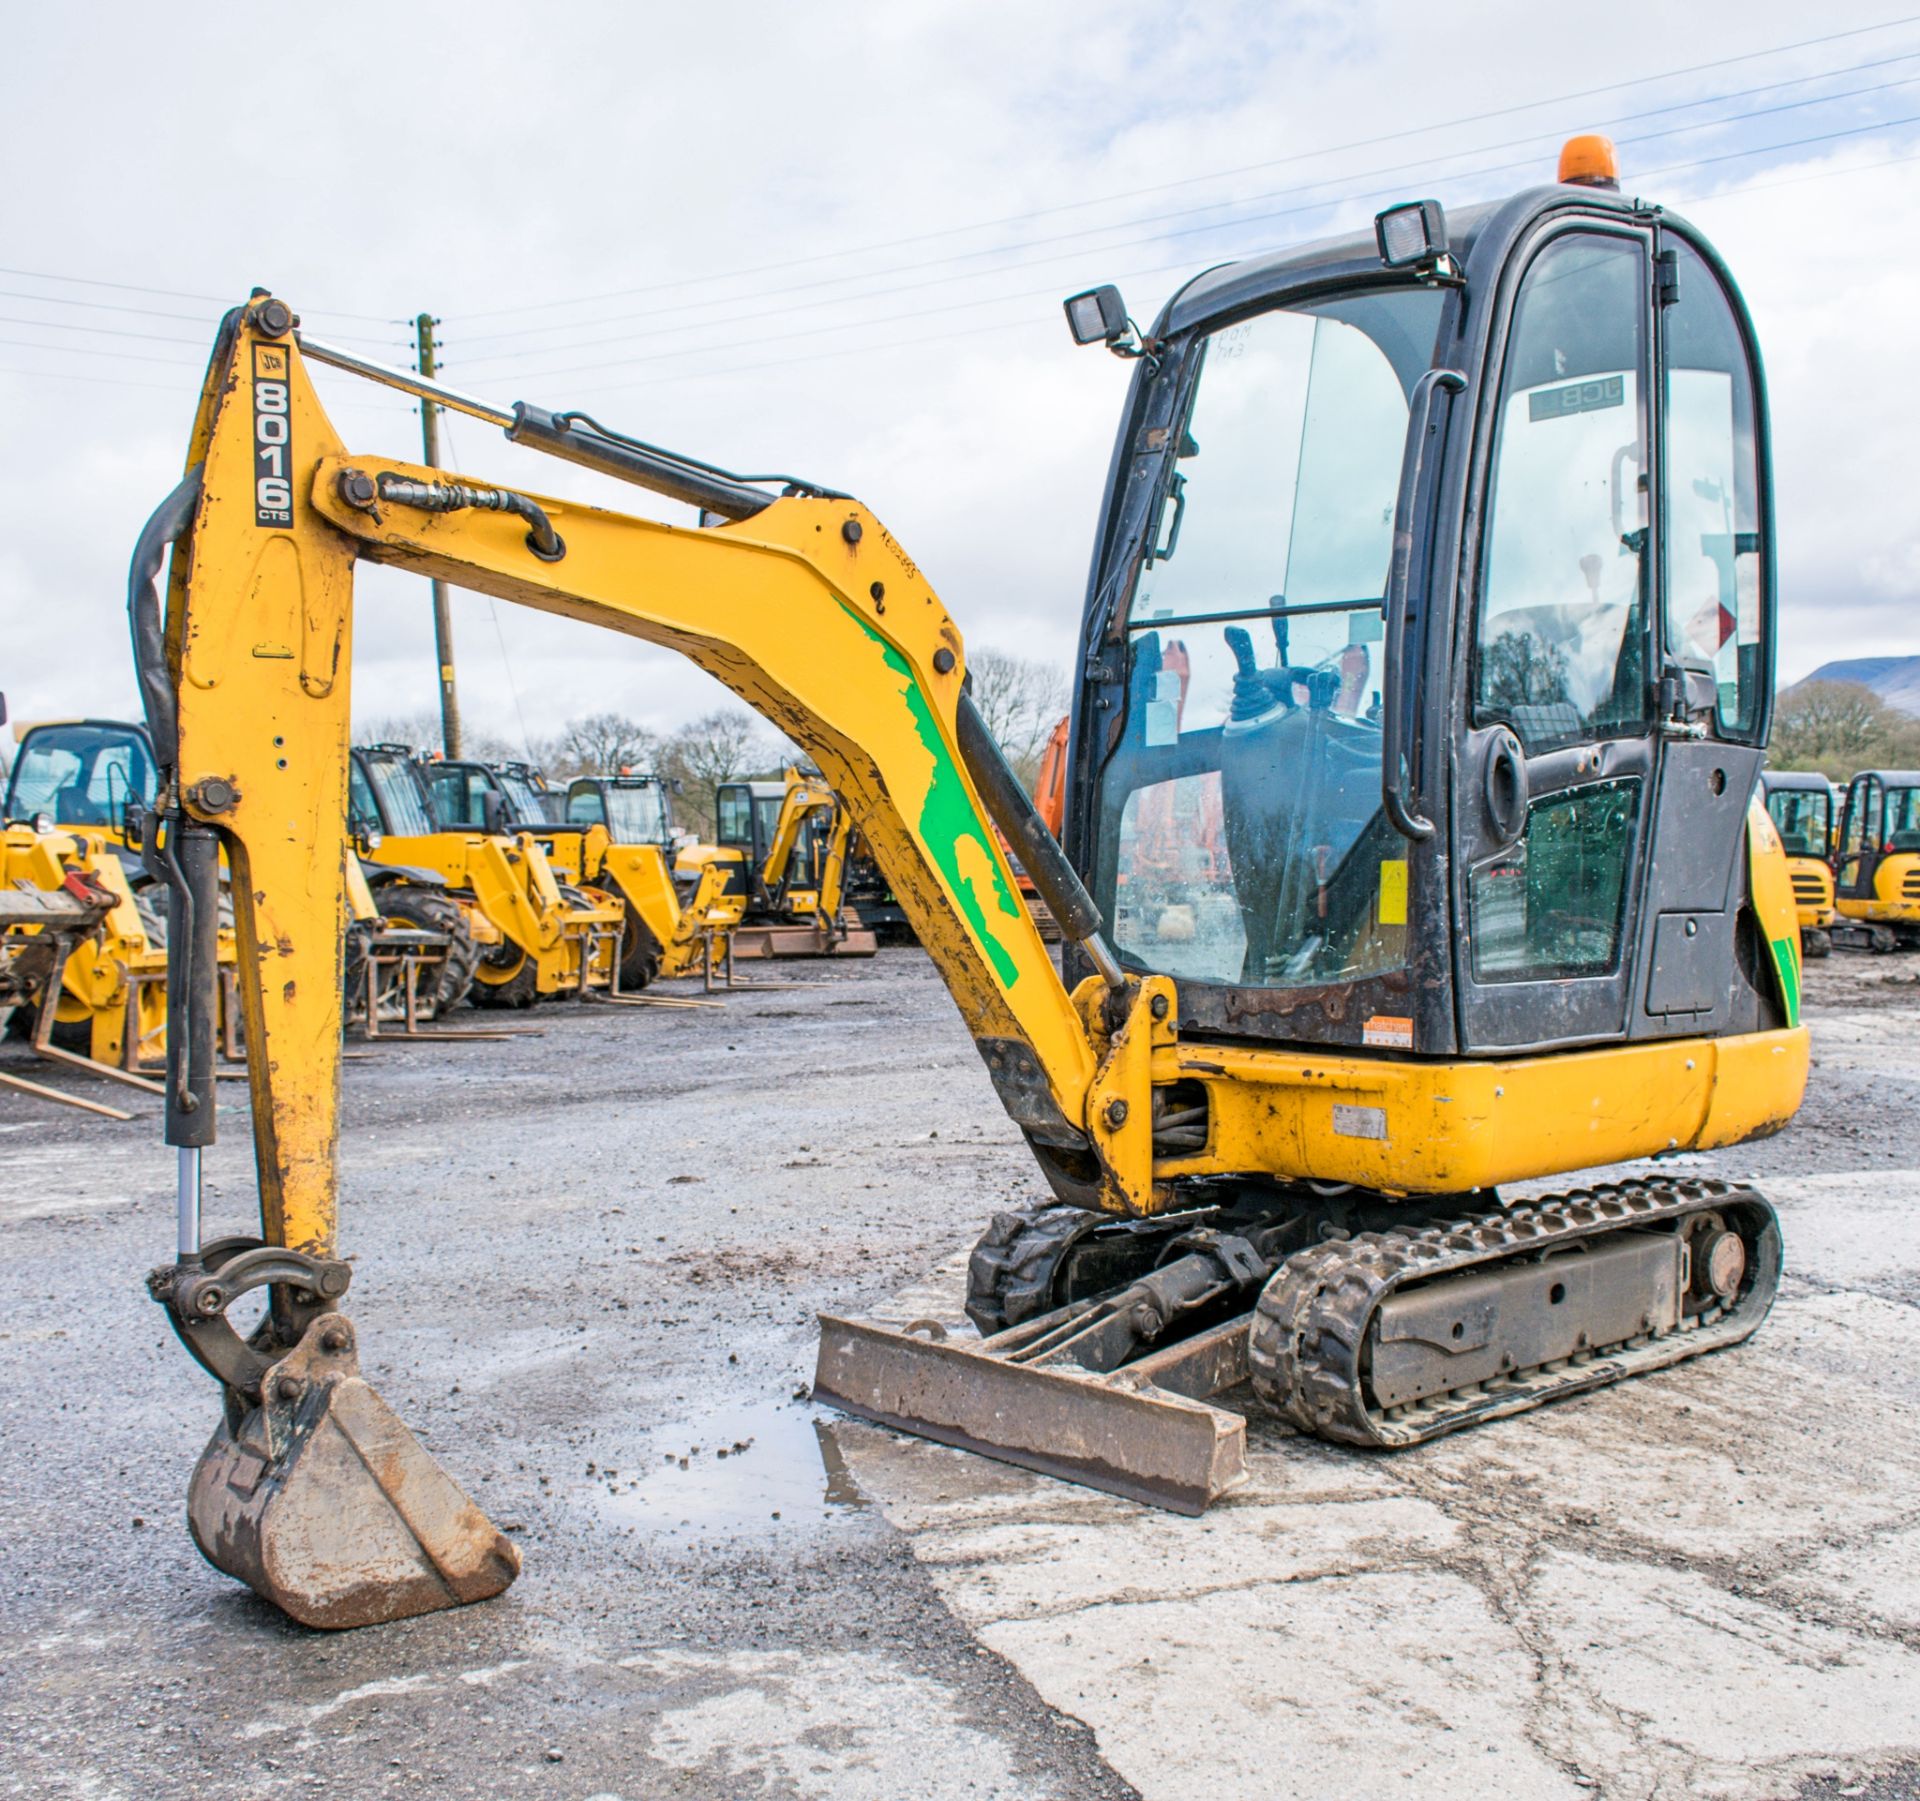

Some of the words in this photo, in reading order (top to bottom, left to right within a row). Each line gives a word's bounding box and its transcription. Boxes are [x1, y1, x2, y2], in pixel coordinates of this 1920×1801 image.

[263, 352, 282, 370] JCB
[255, 382, 291, 510] 8016
[258, 510, 290, 521] CTS
